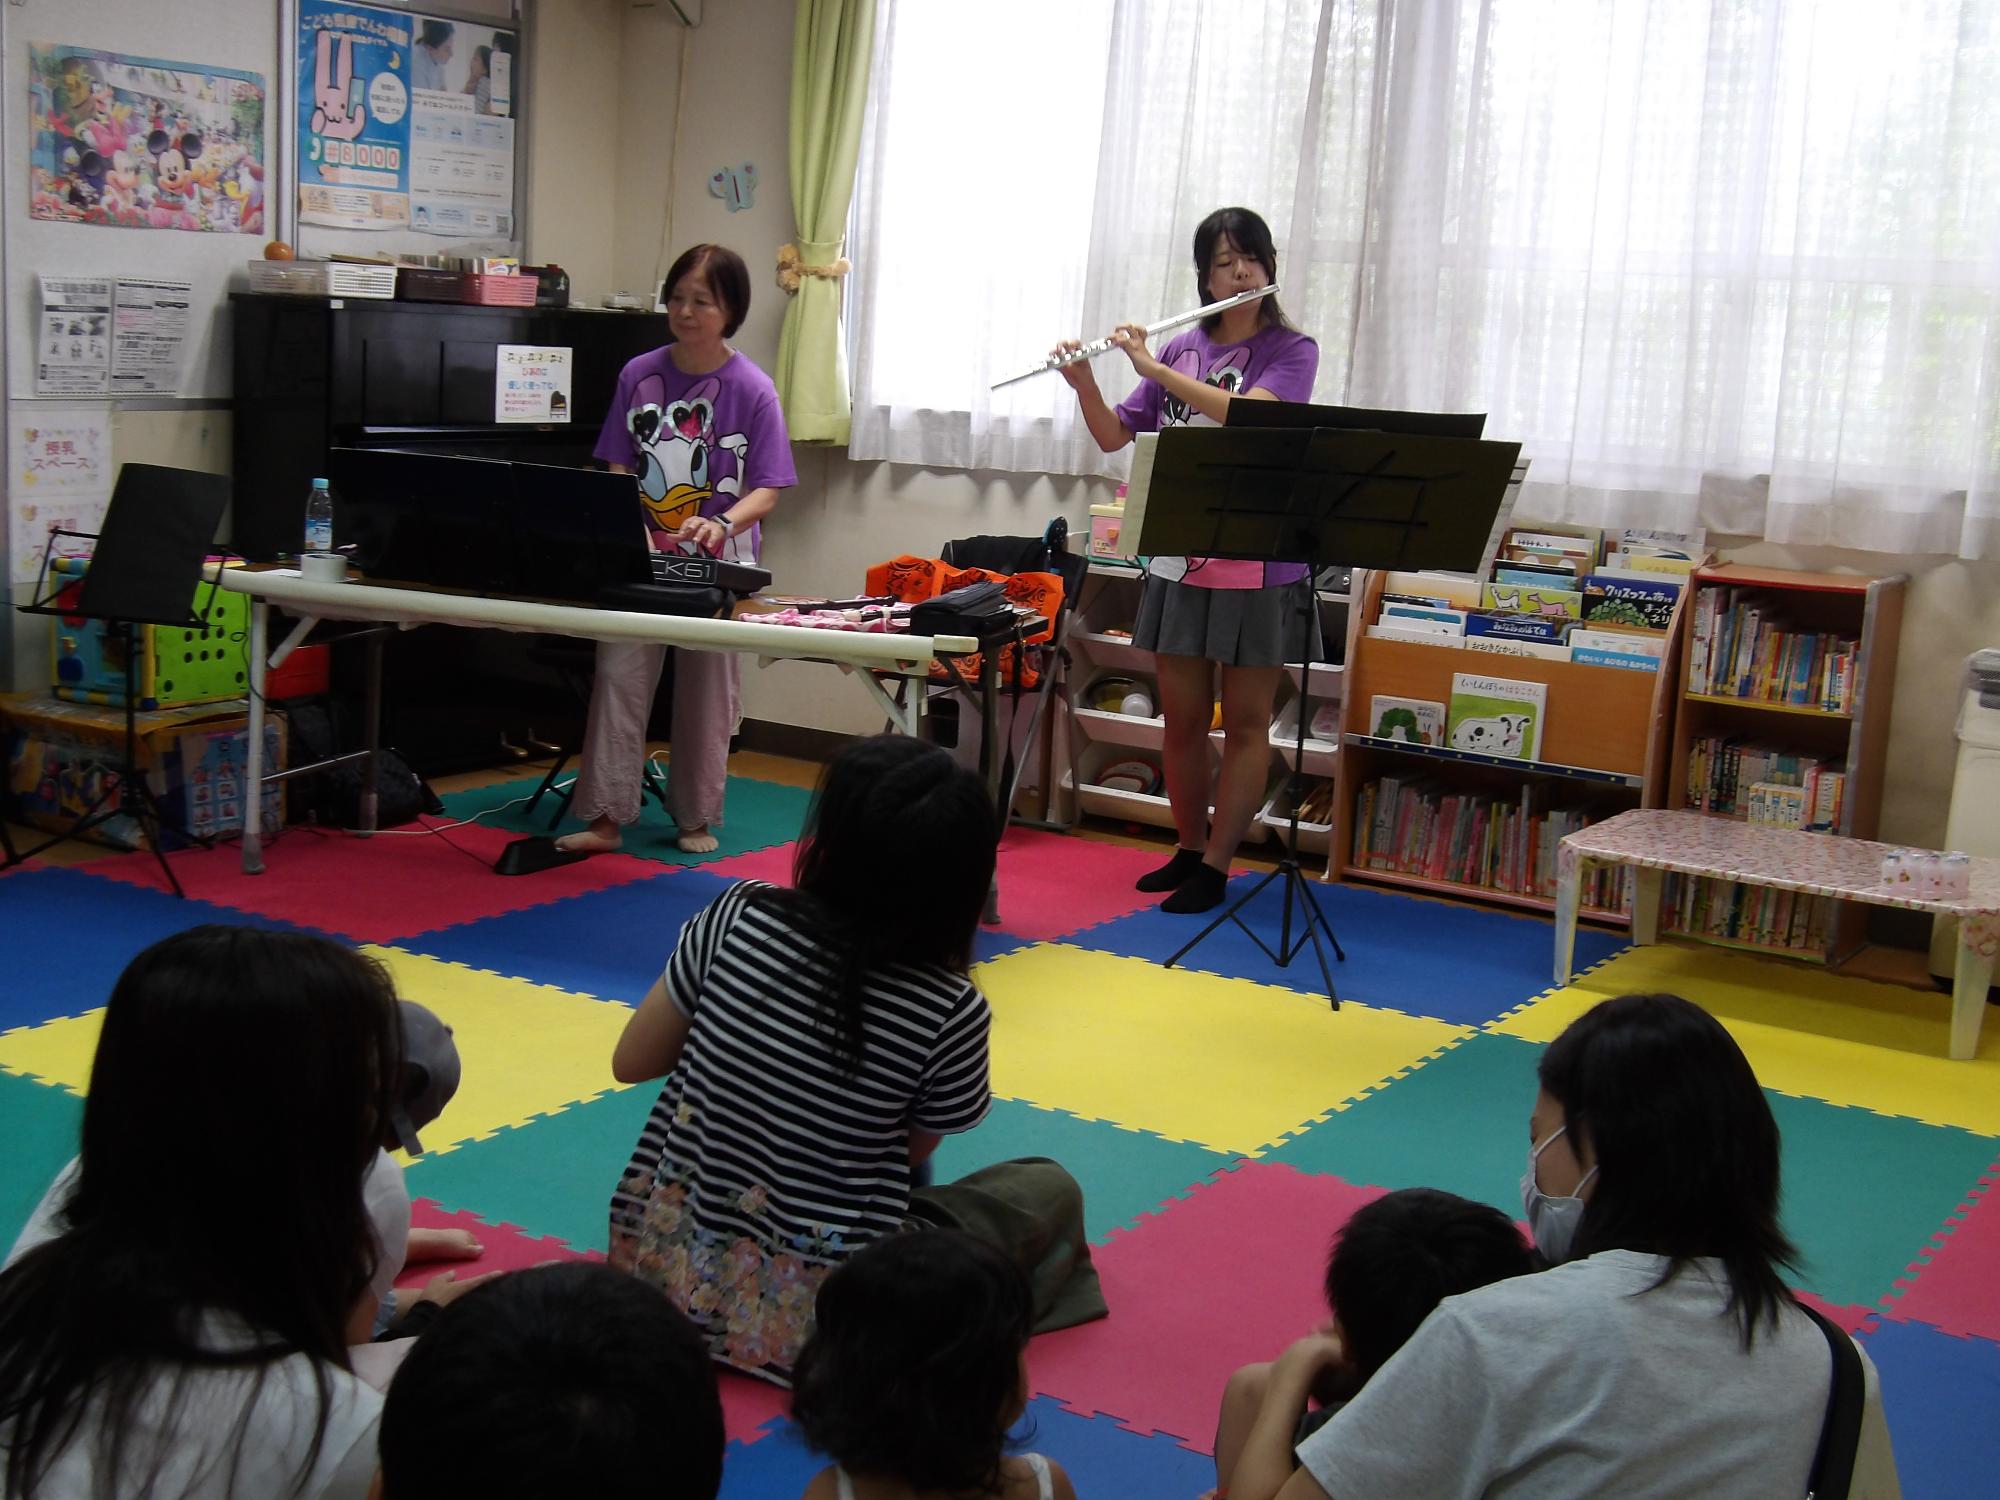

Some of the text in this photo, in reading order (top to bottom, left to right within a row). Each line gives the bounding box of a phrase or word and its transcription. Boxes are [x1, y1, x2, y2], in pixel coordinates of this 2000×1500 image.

[326, 144, 399, 168] #8000
[33, 457, 90, 470] スペース
